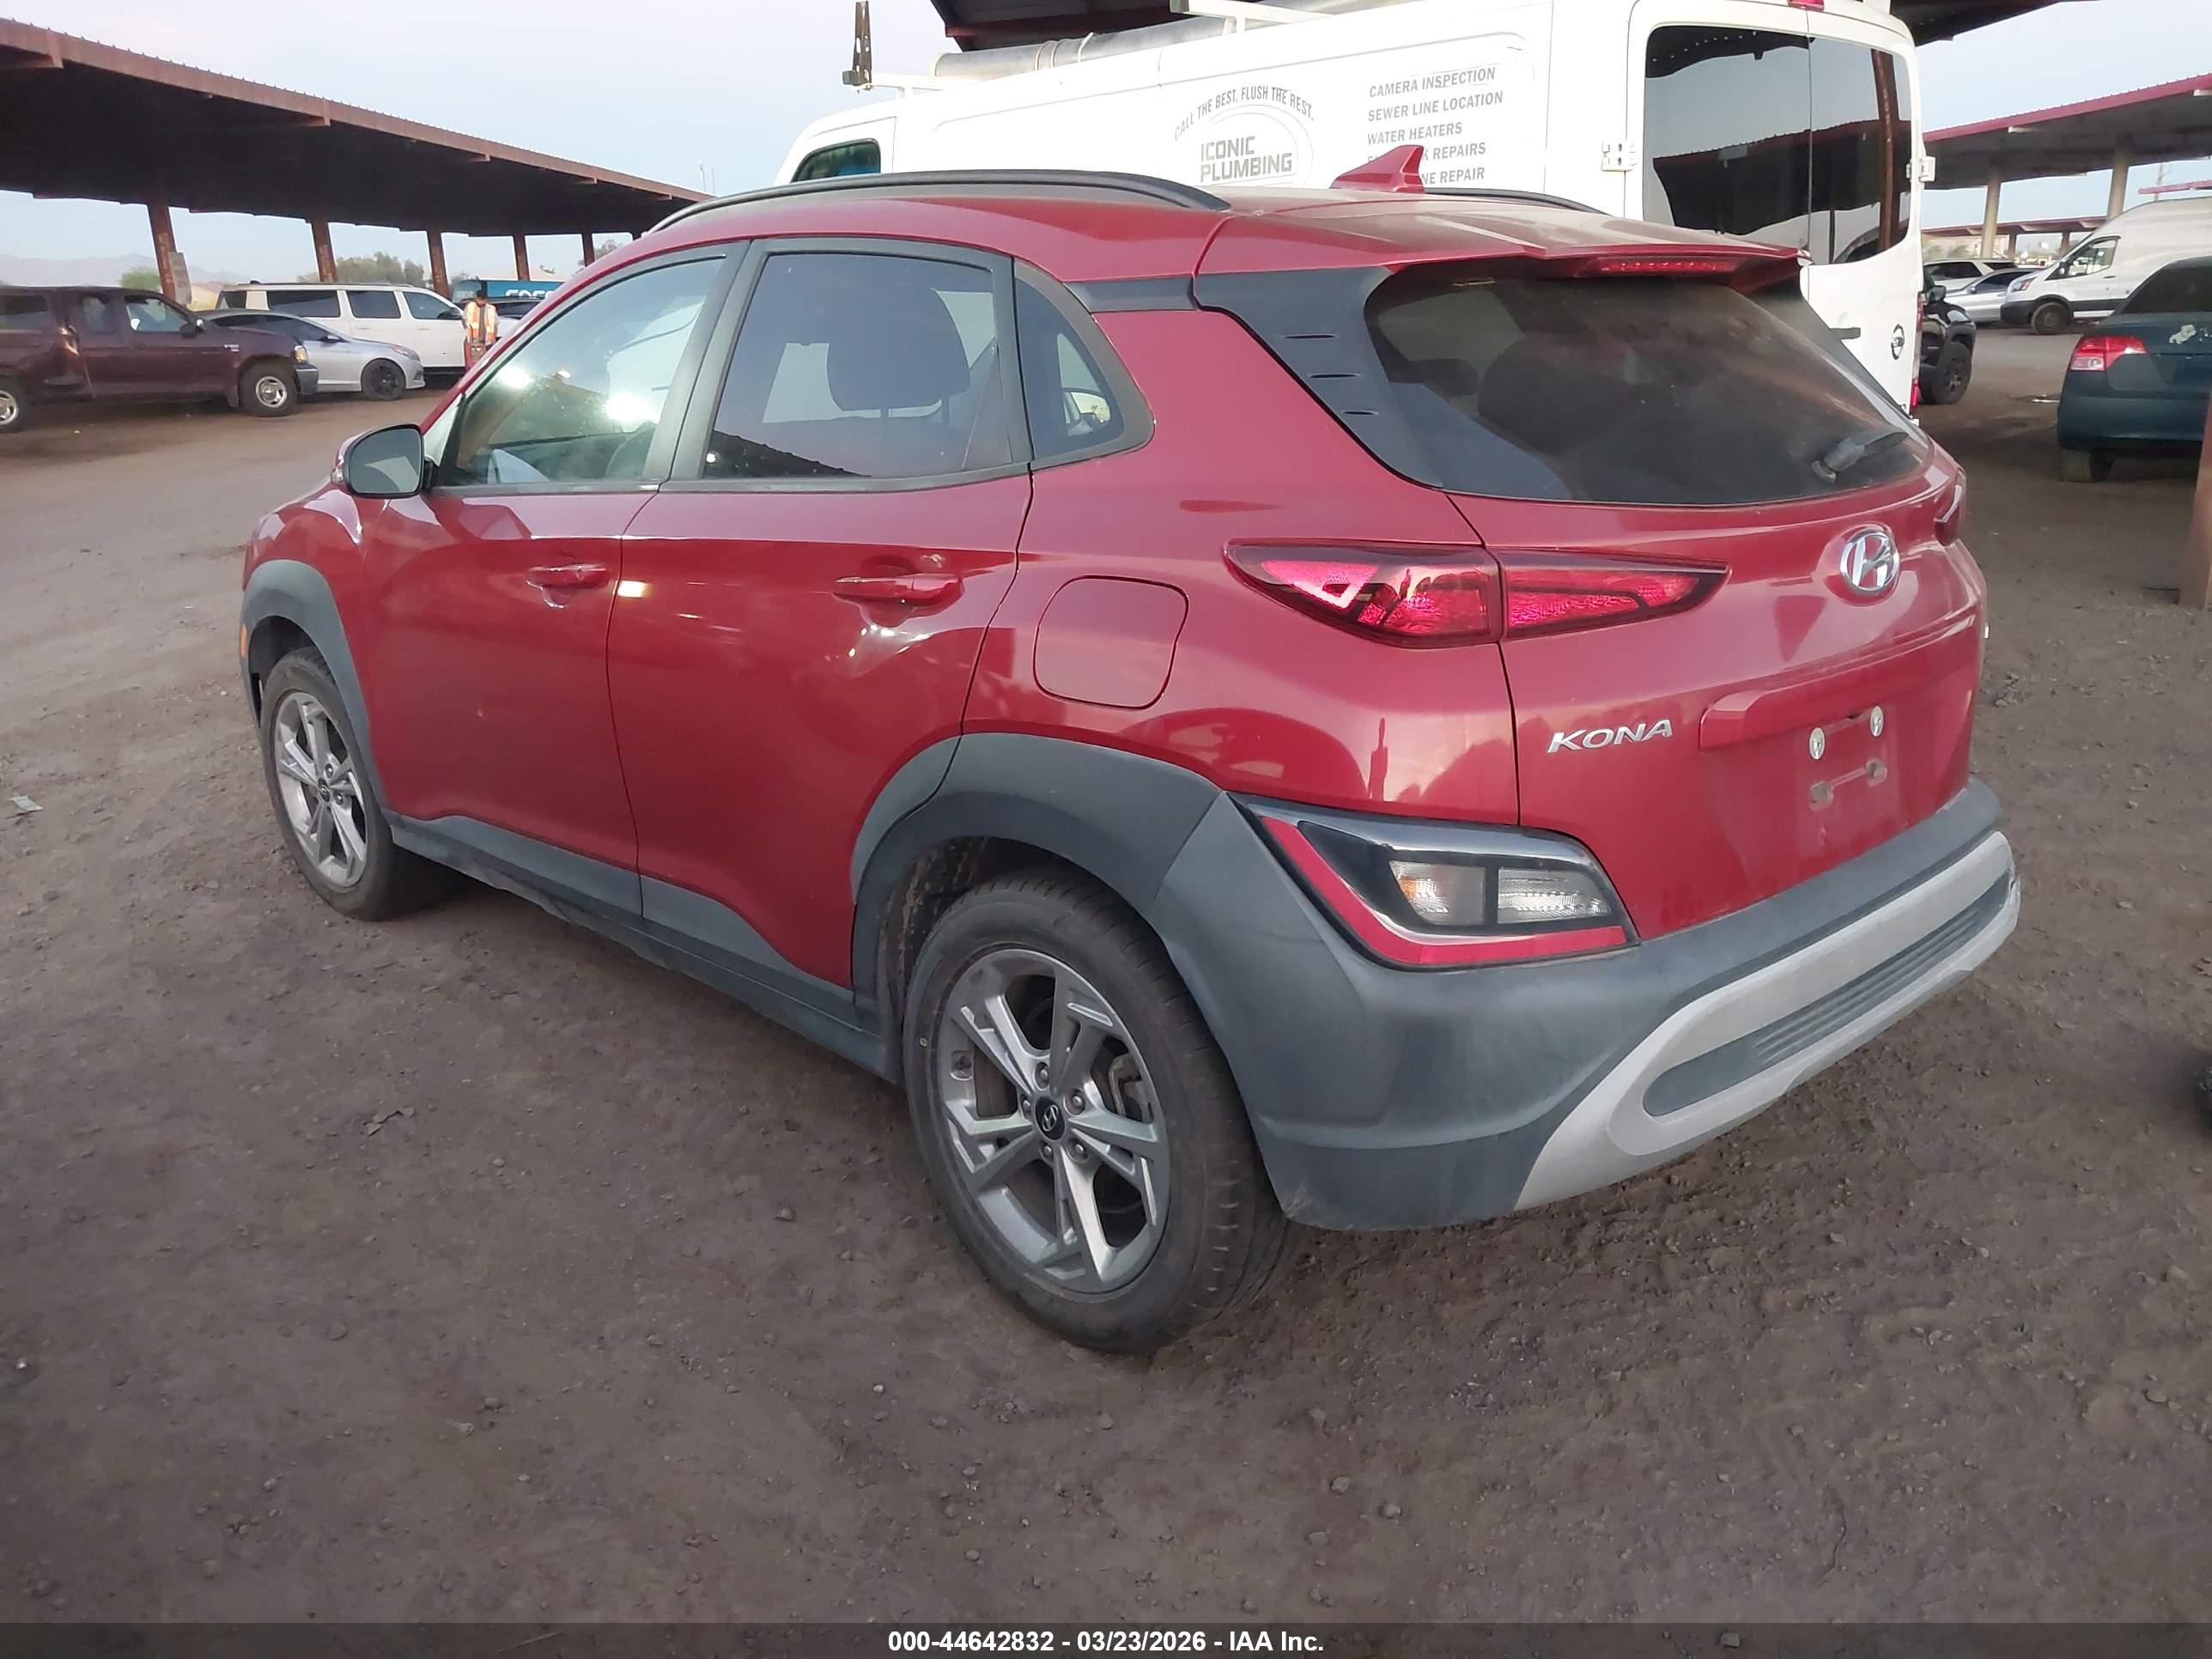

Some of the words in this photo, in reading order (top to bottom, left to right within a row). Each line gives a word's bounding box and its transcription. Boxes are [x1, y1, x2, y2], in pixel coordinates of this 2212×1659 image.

[1370, 79, 1418, 98] CAMERA
[1422, 66, 1496, 89] INSPECTION
[1175, 112, 1194, 140] CALL
[1197, 99, 1212, 120] THE
[1241, 86, 1268, 101] FLUSH
[1271, 87, 1287, 105] THE
[1368, 105, 1409, 122] SEWER
[1413, 100, 1439, 116] LINE
[1443, 90, 1503, 112] LOCATION
[1367, 129, 1406, 145] WATER
[1409, 121, 1462, 140] HEATERS
[1201, 136, 1255, 161] ICONIC
[1432, 142, 1486, 160] REPAIRS
[1200, 153, 1291, 183] PLUMBING
[1440, 167, 1485, 184] REPAIR
[1547, 719, 1673, 753] KONA
